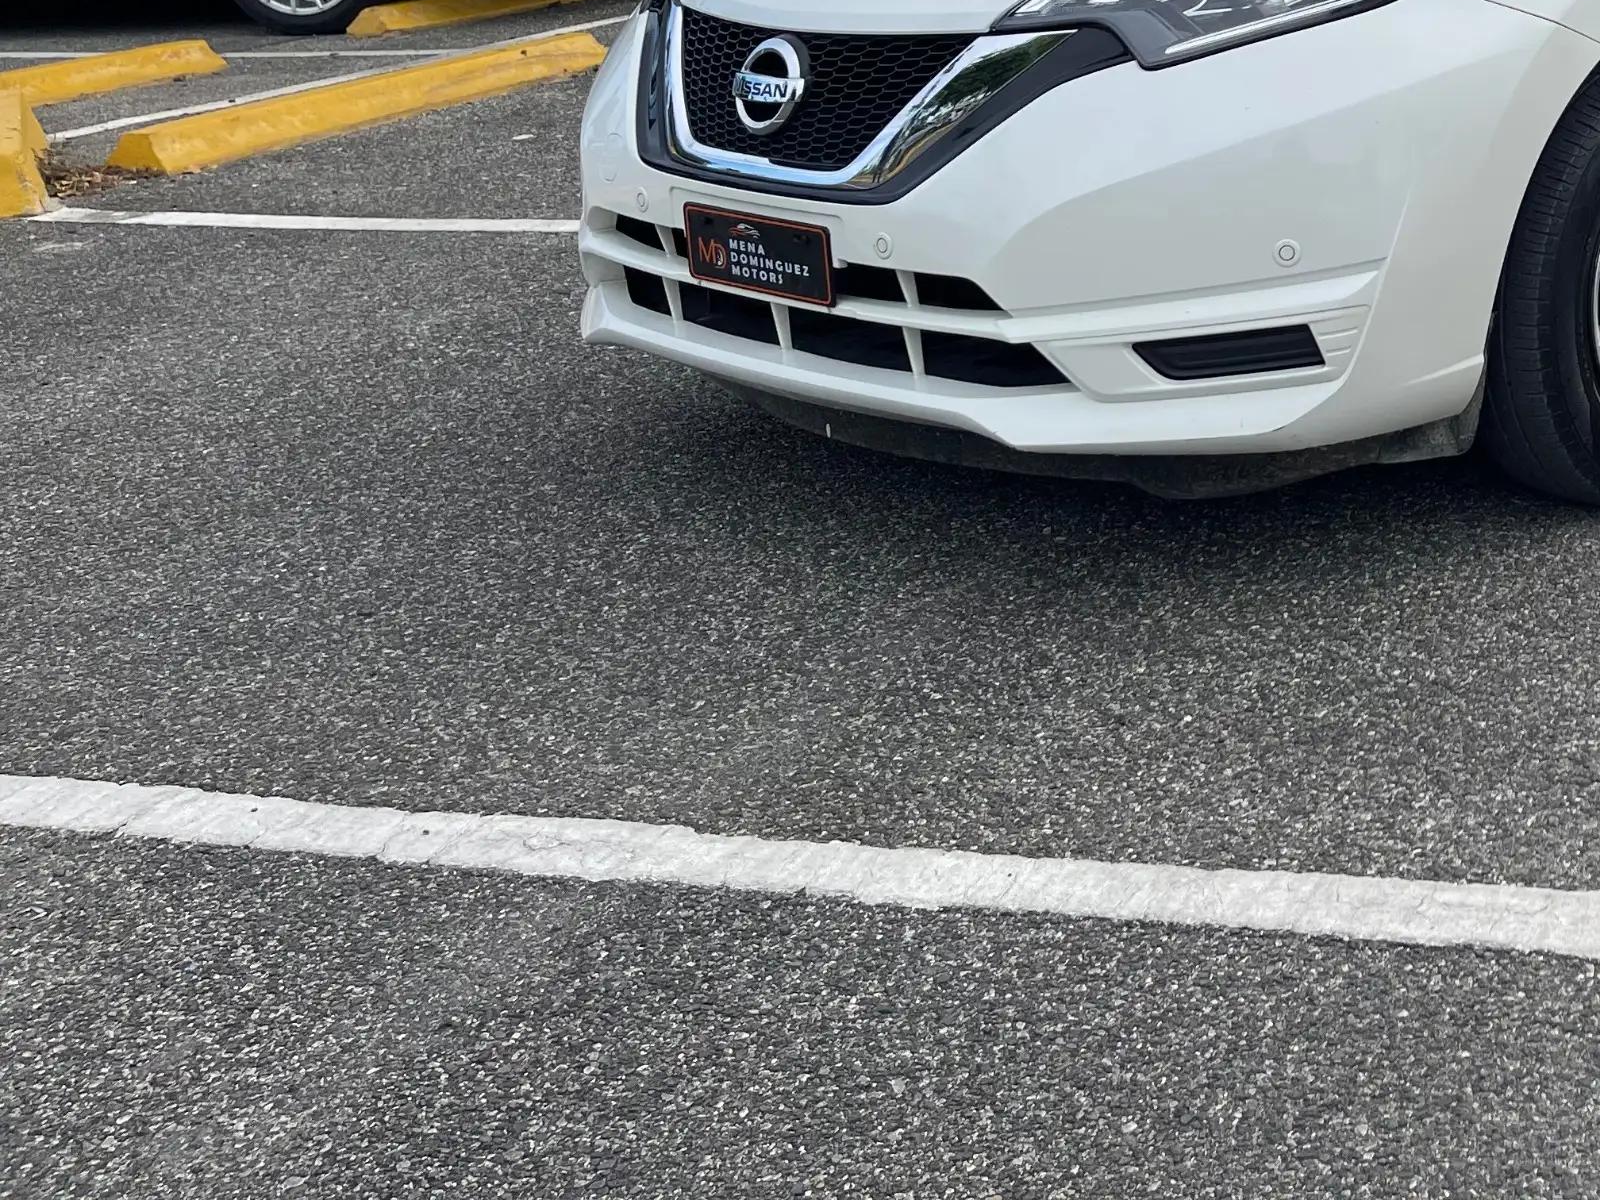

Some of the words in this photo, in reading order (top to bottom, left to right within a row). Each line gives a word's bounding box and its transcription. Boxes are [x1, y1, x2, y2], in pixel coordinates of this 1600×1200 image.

[735, 74, 788, 98] NISSAN
[728, 239, 766, 256] MENA
[730, 251, 810, 277] DOMINGUEZ
[731, 264, 784, 285] MOTORS
